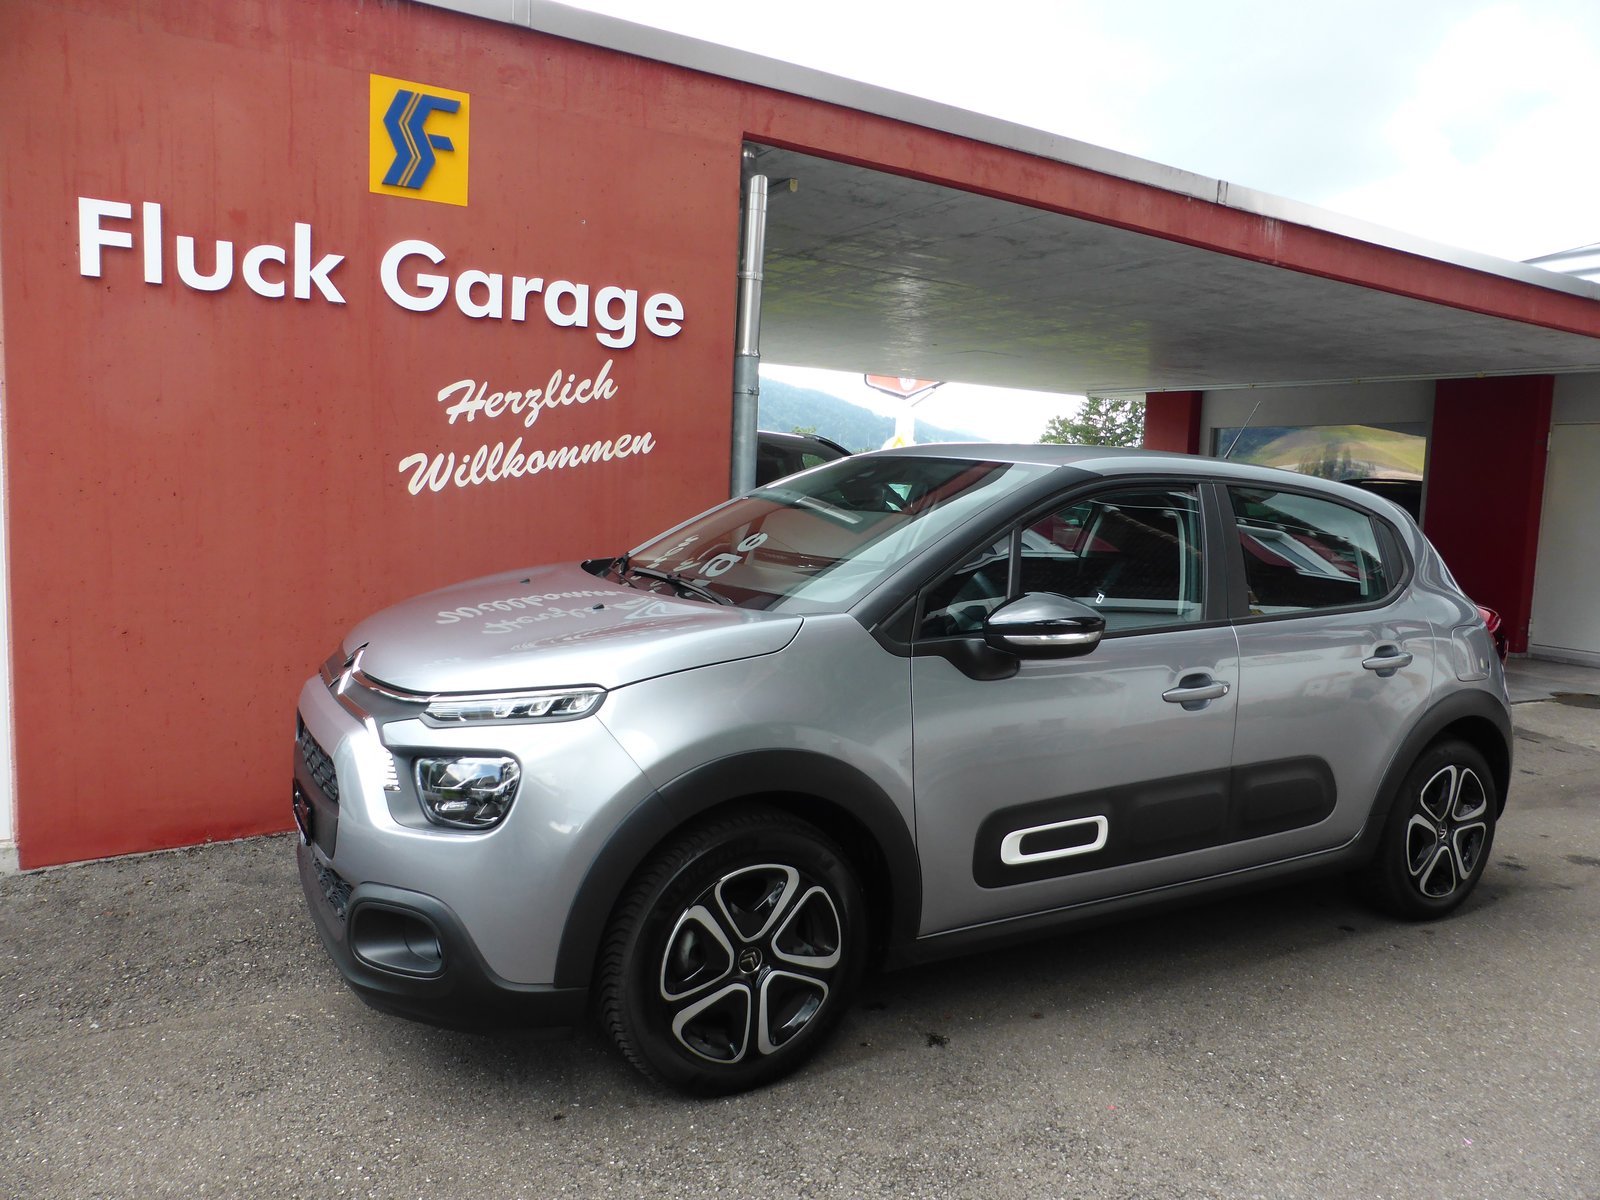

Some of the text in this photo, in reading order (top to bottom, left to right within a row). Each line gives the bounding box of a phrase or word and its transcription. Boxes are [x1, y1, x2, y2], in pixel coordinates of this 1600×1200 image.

[78, 197, 686, 350] Fluck Garage
[437, 359, 619, 428] Herzlich
[398, 430, 656, 496] Willkommen
